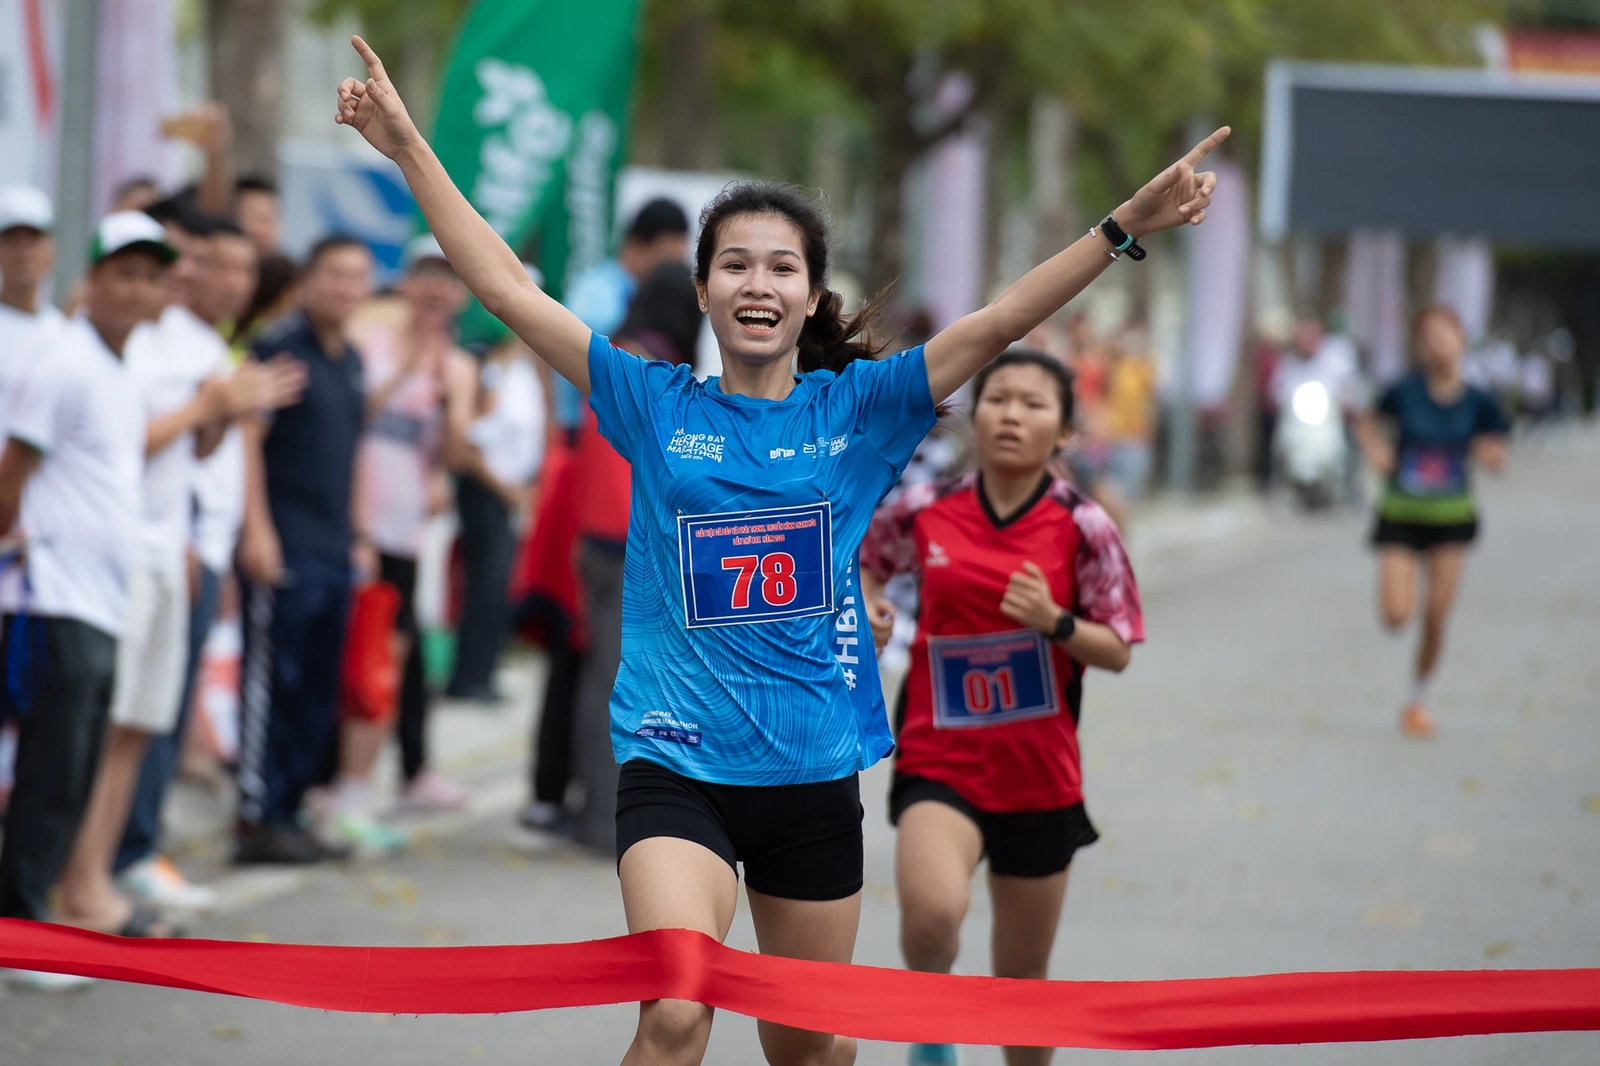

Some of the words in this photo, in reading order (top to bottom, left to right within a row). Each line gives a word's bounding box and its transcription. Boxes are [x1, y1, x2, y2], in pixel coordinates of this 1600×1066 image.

[666, 445, 722, 463] MARATHON
[707, 435, 725, 443] BAY
[721, 552, 797, 609] 78
[963, 667, 1016, 714] 01
